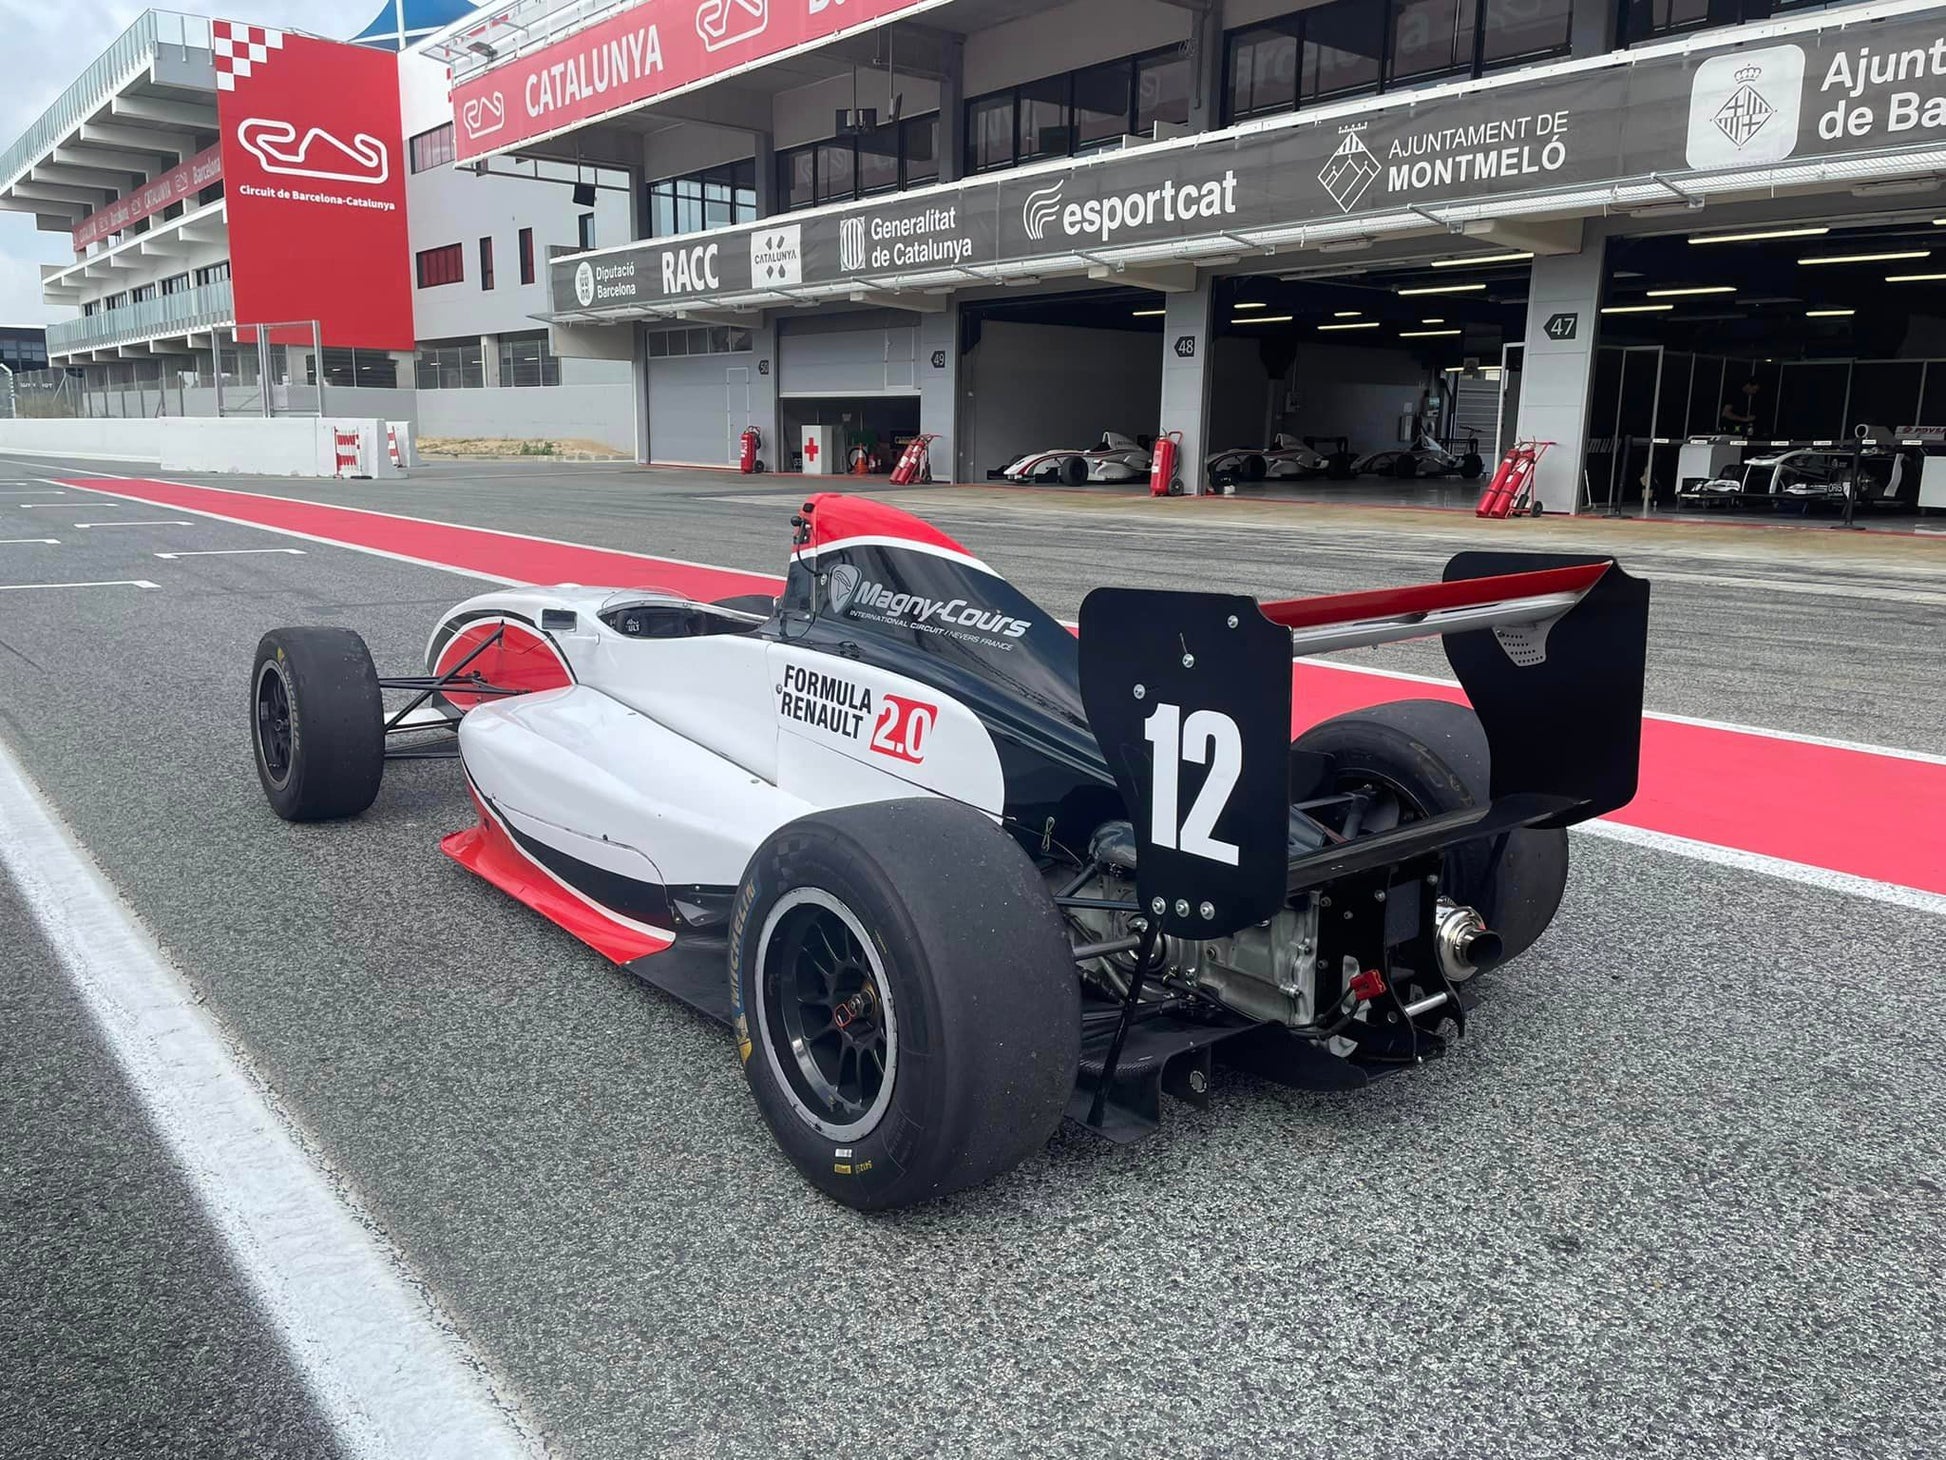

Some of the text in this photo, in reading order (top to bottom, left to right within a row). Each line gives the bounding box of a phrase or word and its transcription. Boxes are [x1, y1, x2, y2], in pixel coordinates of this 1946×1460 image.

[525, 24, 664, 118] CATALUNYA
[1820, 38, 1946, 97] Ajunt
[1388, 110, 1569, 159] AJUNTAMENT DE
[1818, 100, 1874, 140] de
[1387, 134, 1566, 192] MONTMELÓ
[239, 185, 396, 211] Circuit de Barcelona-Catalunya
[1063, 170, 1237, 241] esportcat
[871, 206, 956, 240] Generalitat
[596, 261, 635, 282] Diputació
[661, 243, 719, 294] RACC
[754, 249, 797, 265] CATALUNYA
[871, 238, 972, 268] de Catalunya
[597, 284, 636, 299] Barcelona
[1178, 338, 1195, 355] 48
[1550, 317, 1576, 336] 47
[933, 353, 945, 366] 49
[850, 610, 908, 628] INTERNATIONAL
[910, 622, 945, 636] CIRCUIT
[950, 631, 980, 643] NEVERS
[980, 637, 1014, 651] FRANCE
[854, 581, 1032, 638] Magny-Cours
[784, 664, 872, 715] FORMULA
[781, 691, 932, 759] RENAULT 2.0
[1144, 703, 1242, 866] 12
[730, 878, 757, 1009] MICHELIN
